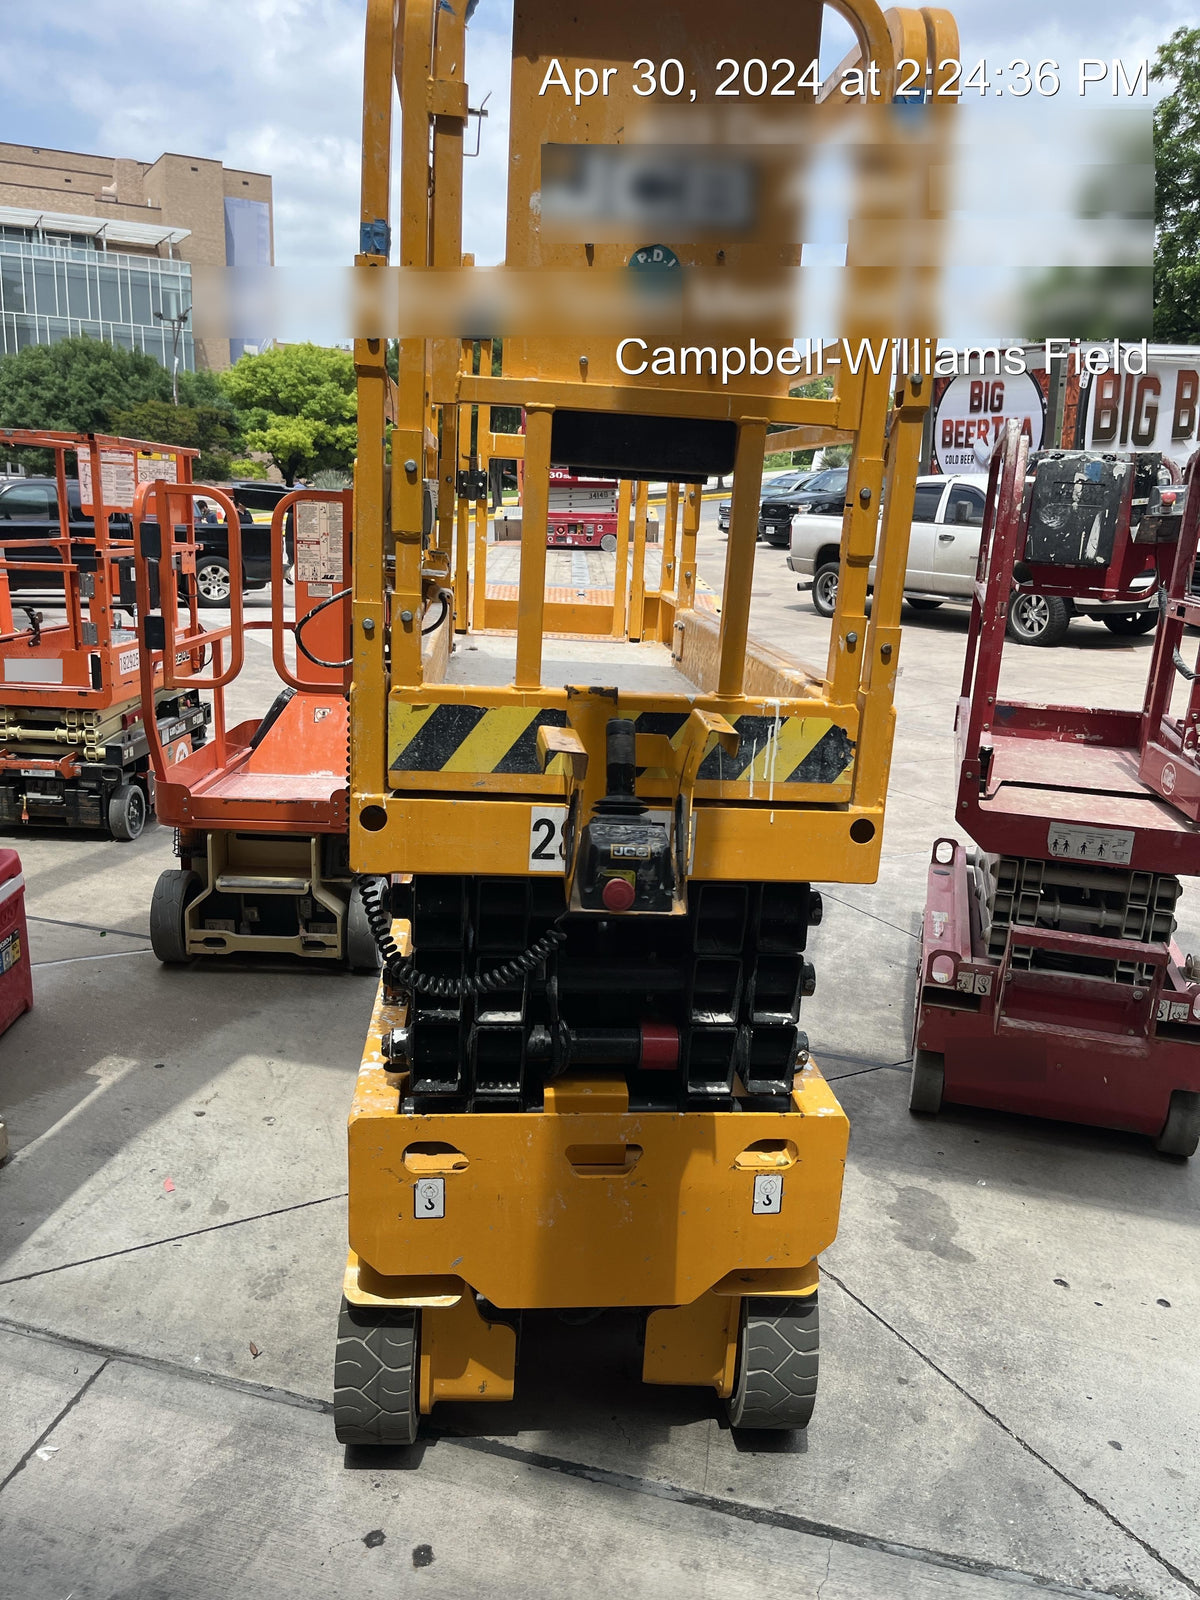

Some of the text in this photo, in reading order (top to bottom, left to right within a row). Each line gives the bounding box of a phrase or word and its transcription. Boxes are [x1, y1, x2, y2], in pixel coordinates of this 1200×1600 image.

[969, 380, 1005, 414] BIG
[1092, 368, 1200, 447] BIG B
[941, 416, 1033, 449] BEERTA
[945, 454, 975, 465] COLD BEER
